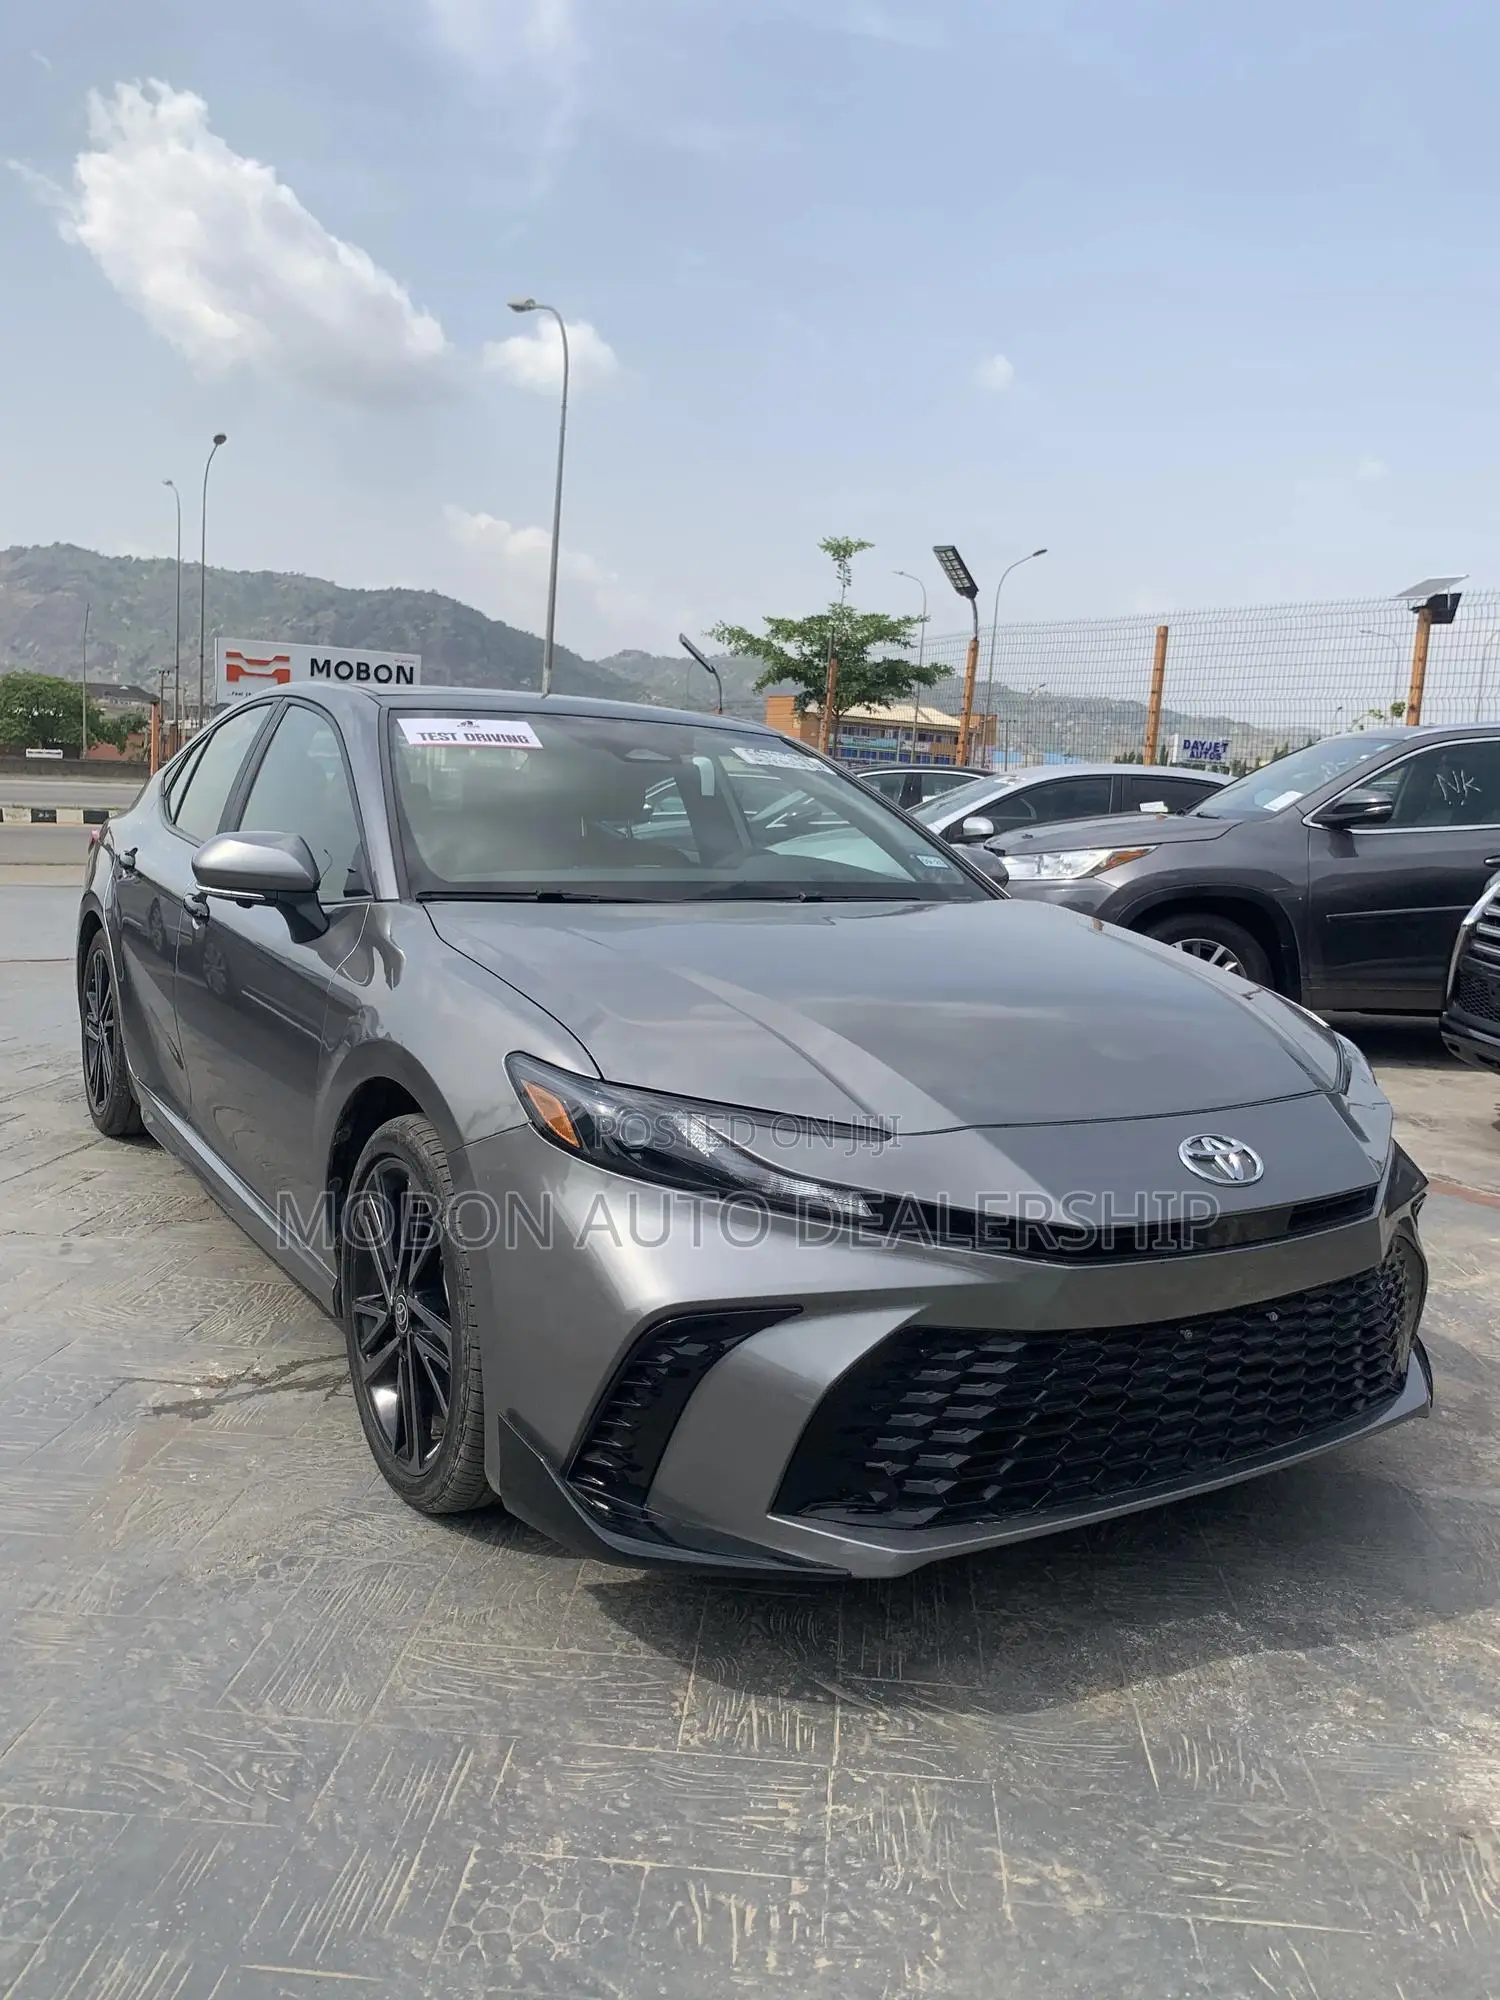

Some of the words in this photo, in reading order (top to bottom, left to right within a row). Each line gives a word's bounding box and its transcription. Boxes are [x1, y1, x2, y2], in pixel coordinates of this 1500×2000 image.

[310, 658, 413, 684] MOBON
[416, 732, 458, 741] TEST
[464, 733, 530, 744] DRIVING
[1183, 740, 1228, 753] DAYJET
[1189, 750, 1222, 761] AUTOS
